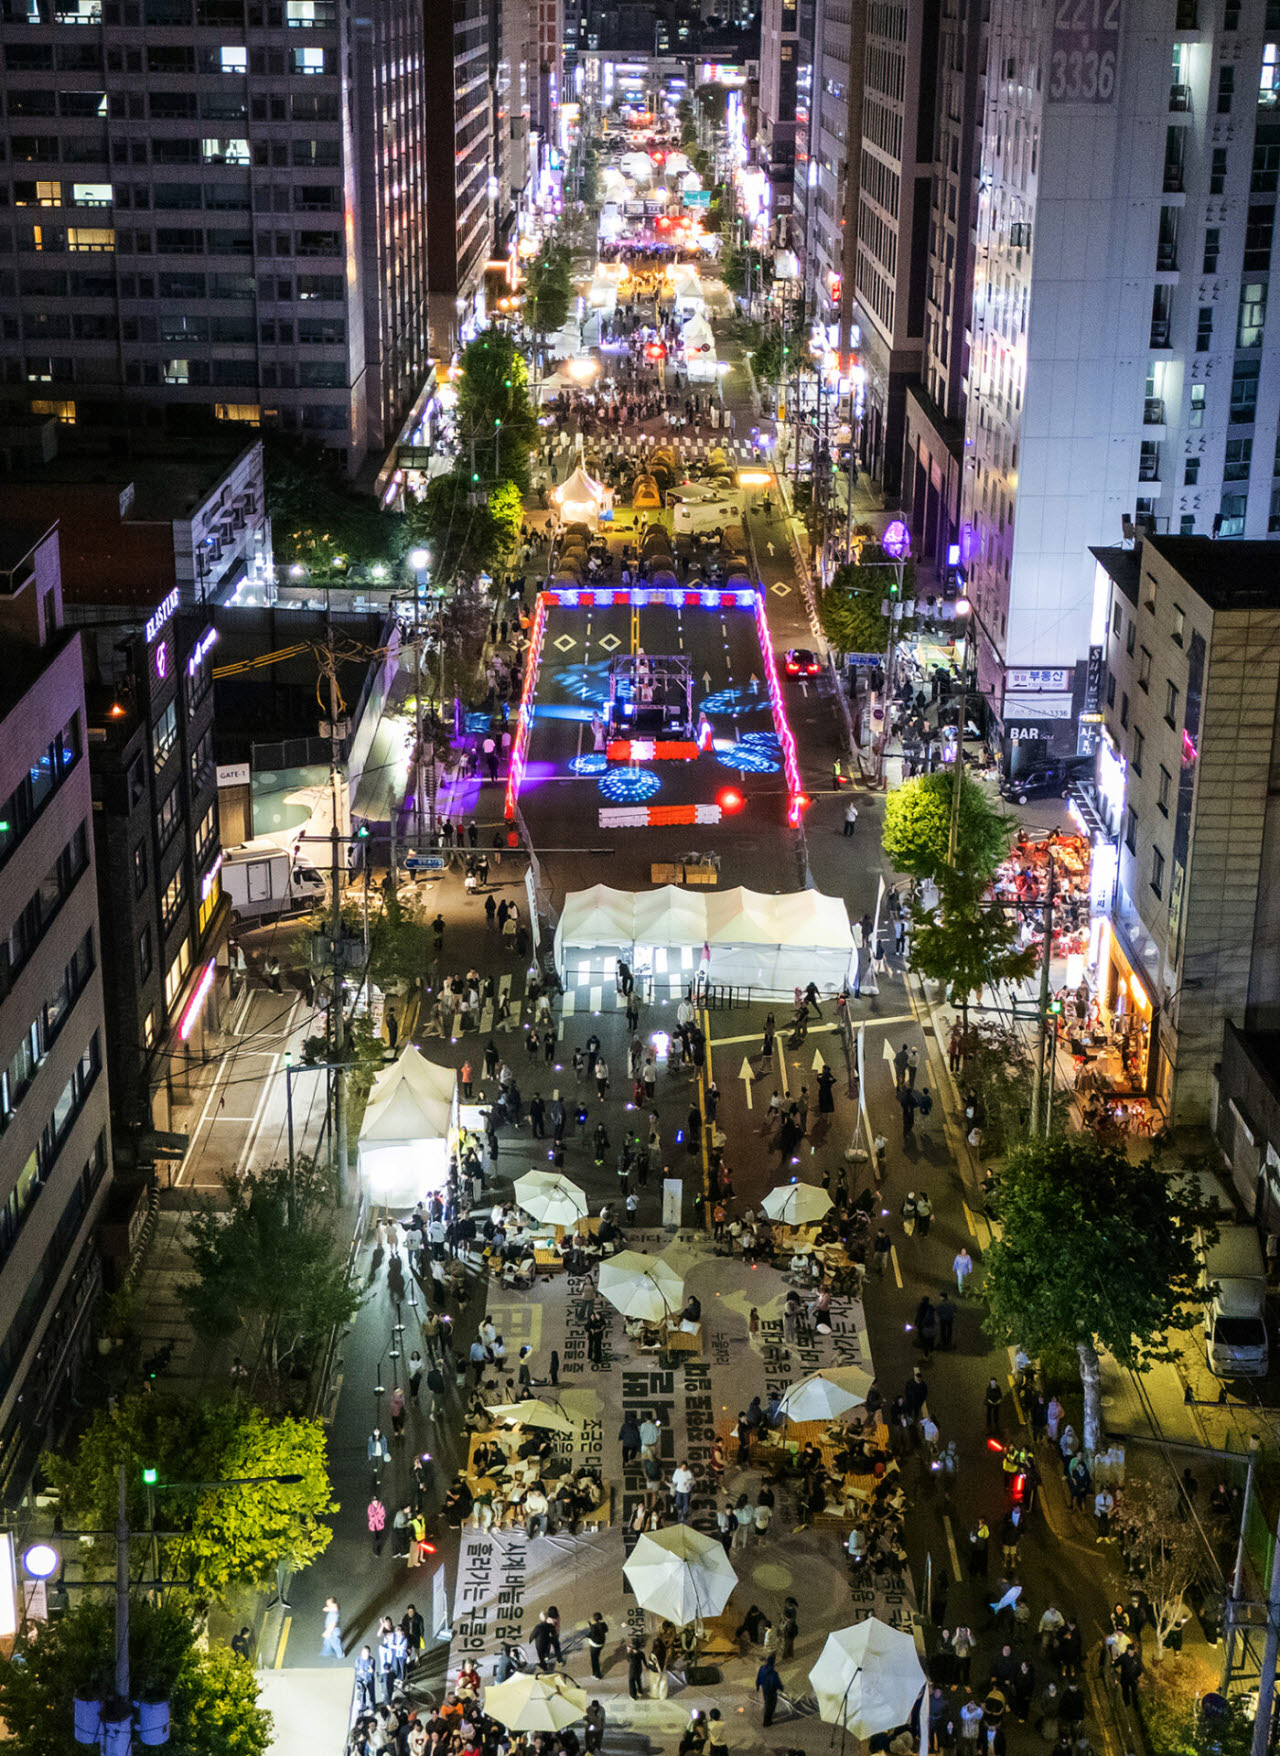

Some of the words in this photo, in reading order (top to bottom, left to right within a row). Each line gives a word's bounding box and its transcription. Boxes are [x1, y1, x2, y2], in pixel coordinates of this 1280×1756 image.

[1050, 50, 1114, 99] 3336
[1029, 671, 1064, 682] 부동산
[1010, 727, 1039, 739] BAR
[760, 1319, 784, 1344] 대로
[684, 1363, 712, 1392] 일대
[581, 1419, 603, 1453] 조금은
[685, 1396, 715, 1442] 장한로
[463, 1543, 494, 1601] 흘러가는
[500, 1543, 527, 1571] 시계
[497, 1575, 525, 1621] 바늘을
[458, 1606, 487, 1652] 구름의
